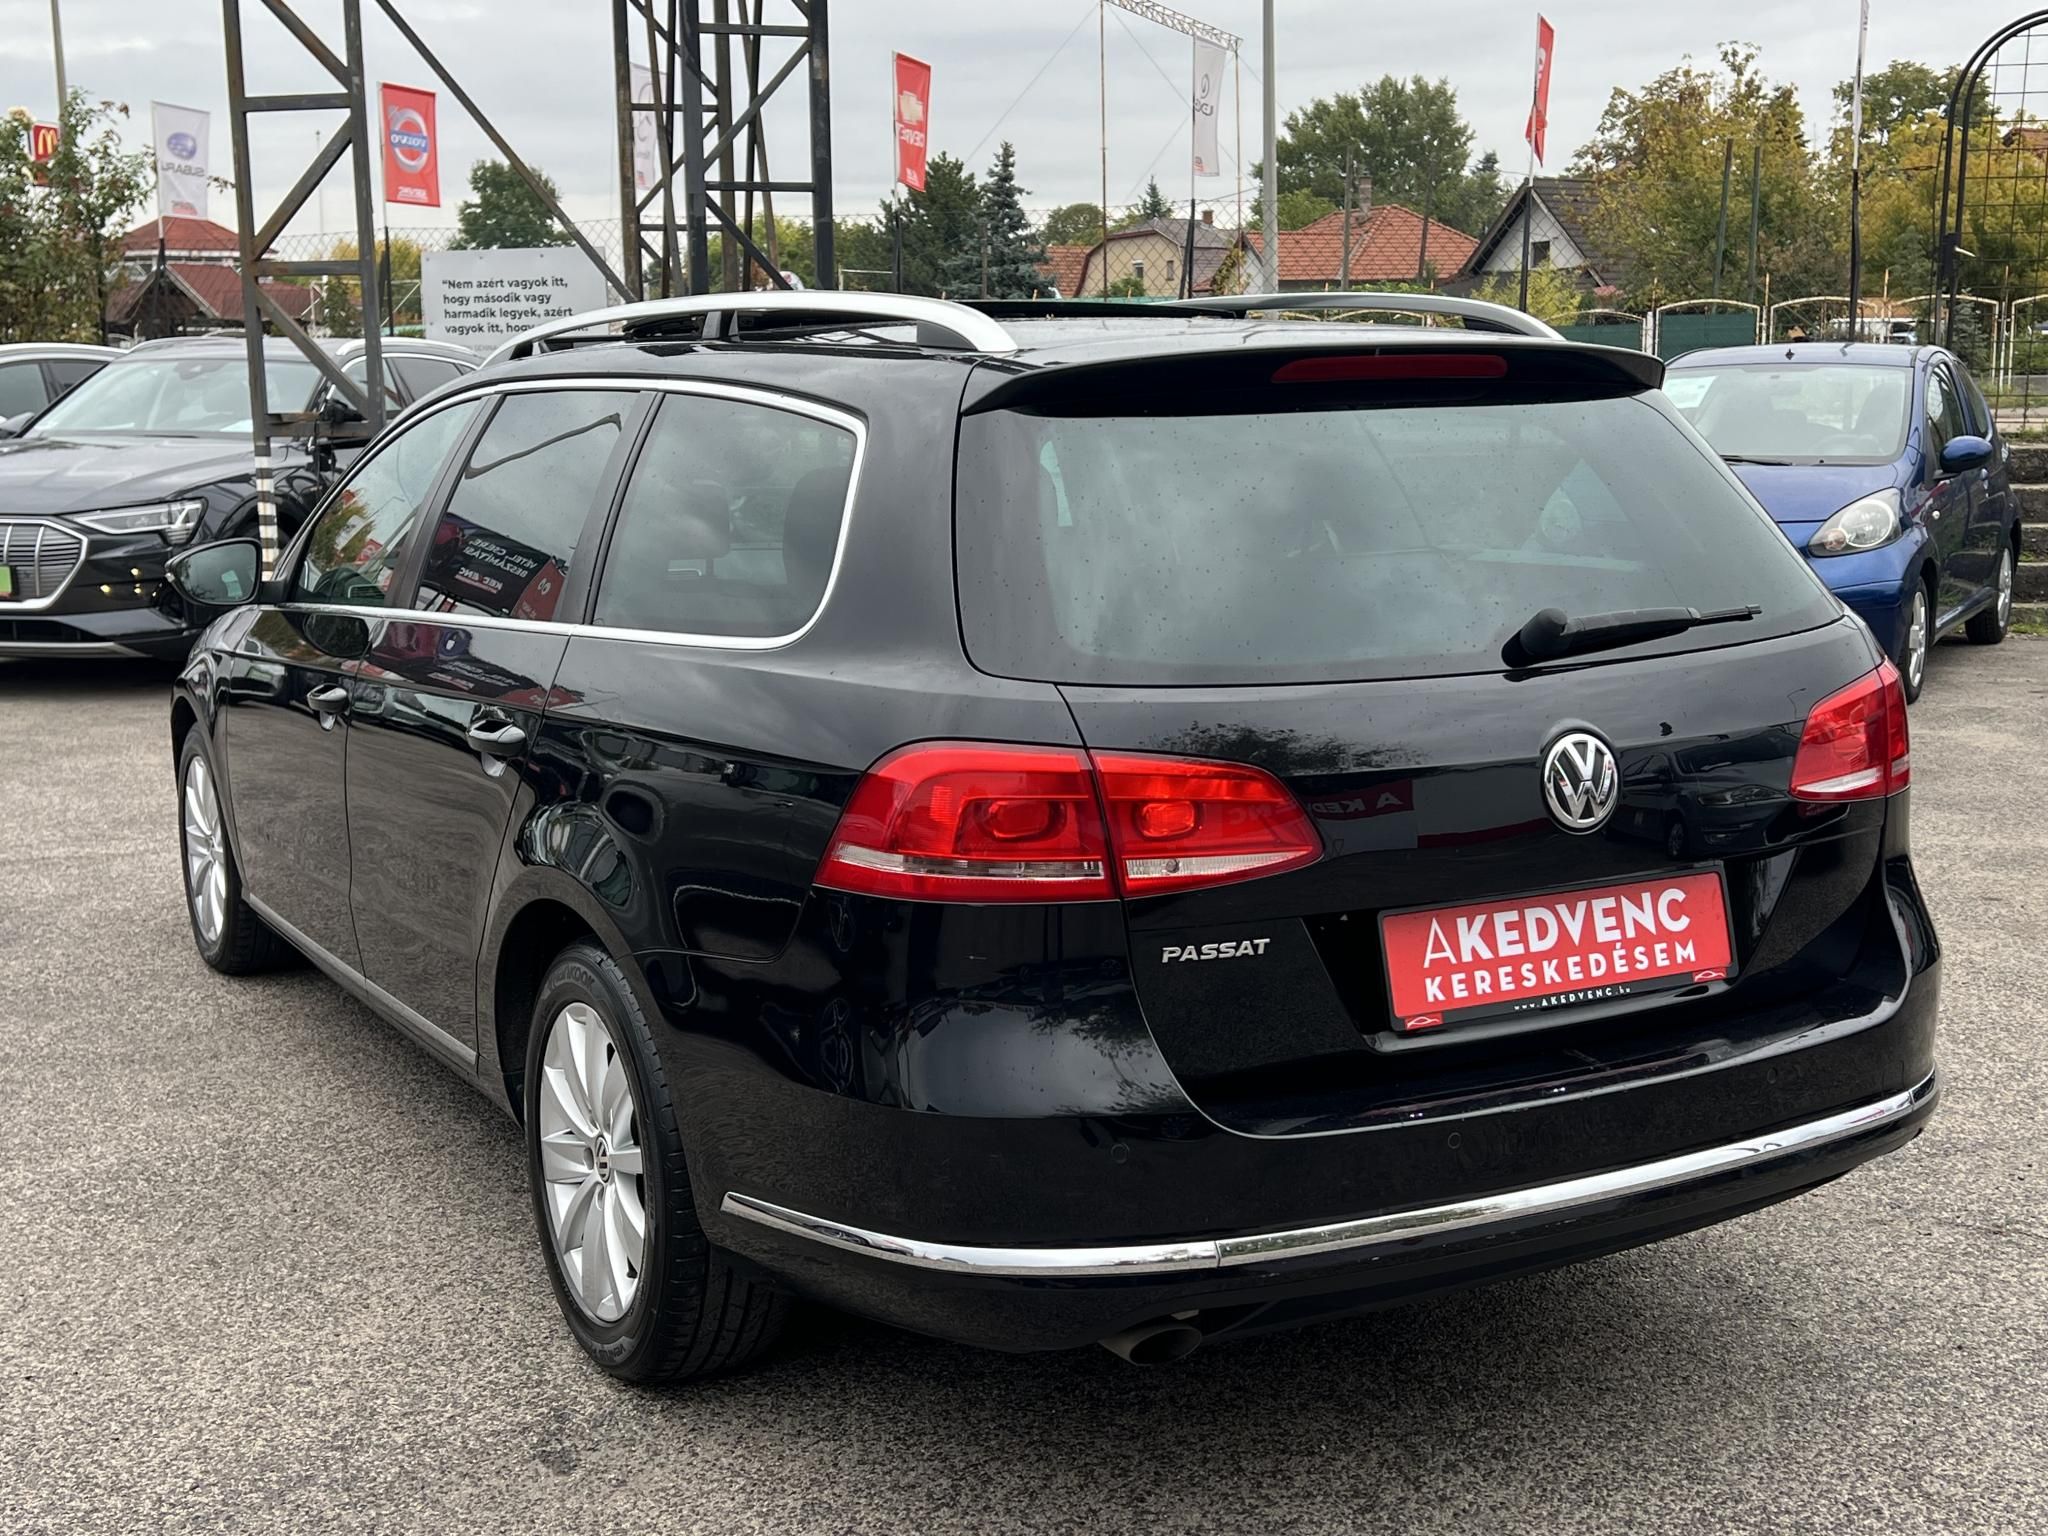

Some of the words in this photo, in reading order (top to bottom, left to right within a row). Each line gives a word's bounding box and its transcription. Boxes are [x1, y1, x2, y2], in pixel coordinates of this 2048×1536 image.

[476, 278, 504, 288] azért
[507, 277, 548, 290] vagyok
[551, 276, 568, 288] itt,
[443, 294, 470, 306] hogy
[473, 292, 521, 303] második
[524, 294, 552, 304] vagy
[444, 307, 496, 318] harmadik
[499, 307, 541, 320] legyek,
[543, 307, 573, 317] azért
[445, 323, 485, 335] vagyok
[487, 323, 504, 334] itt,
[1423, 888, 1691, 968] AKEDVENC
[1161, 938, 1271, 963] PASSAT
[1424, 938, 1697, 1003] KERESKEDÉSEM
